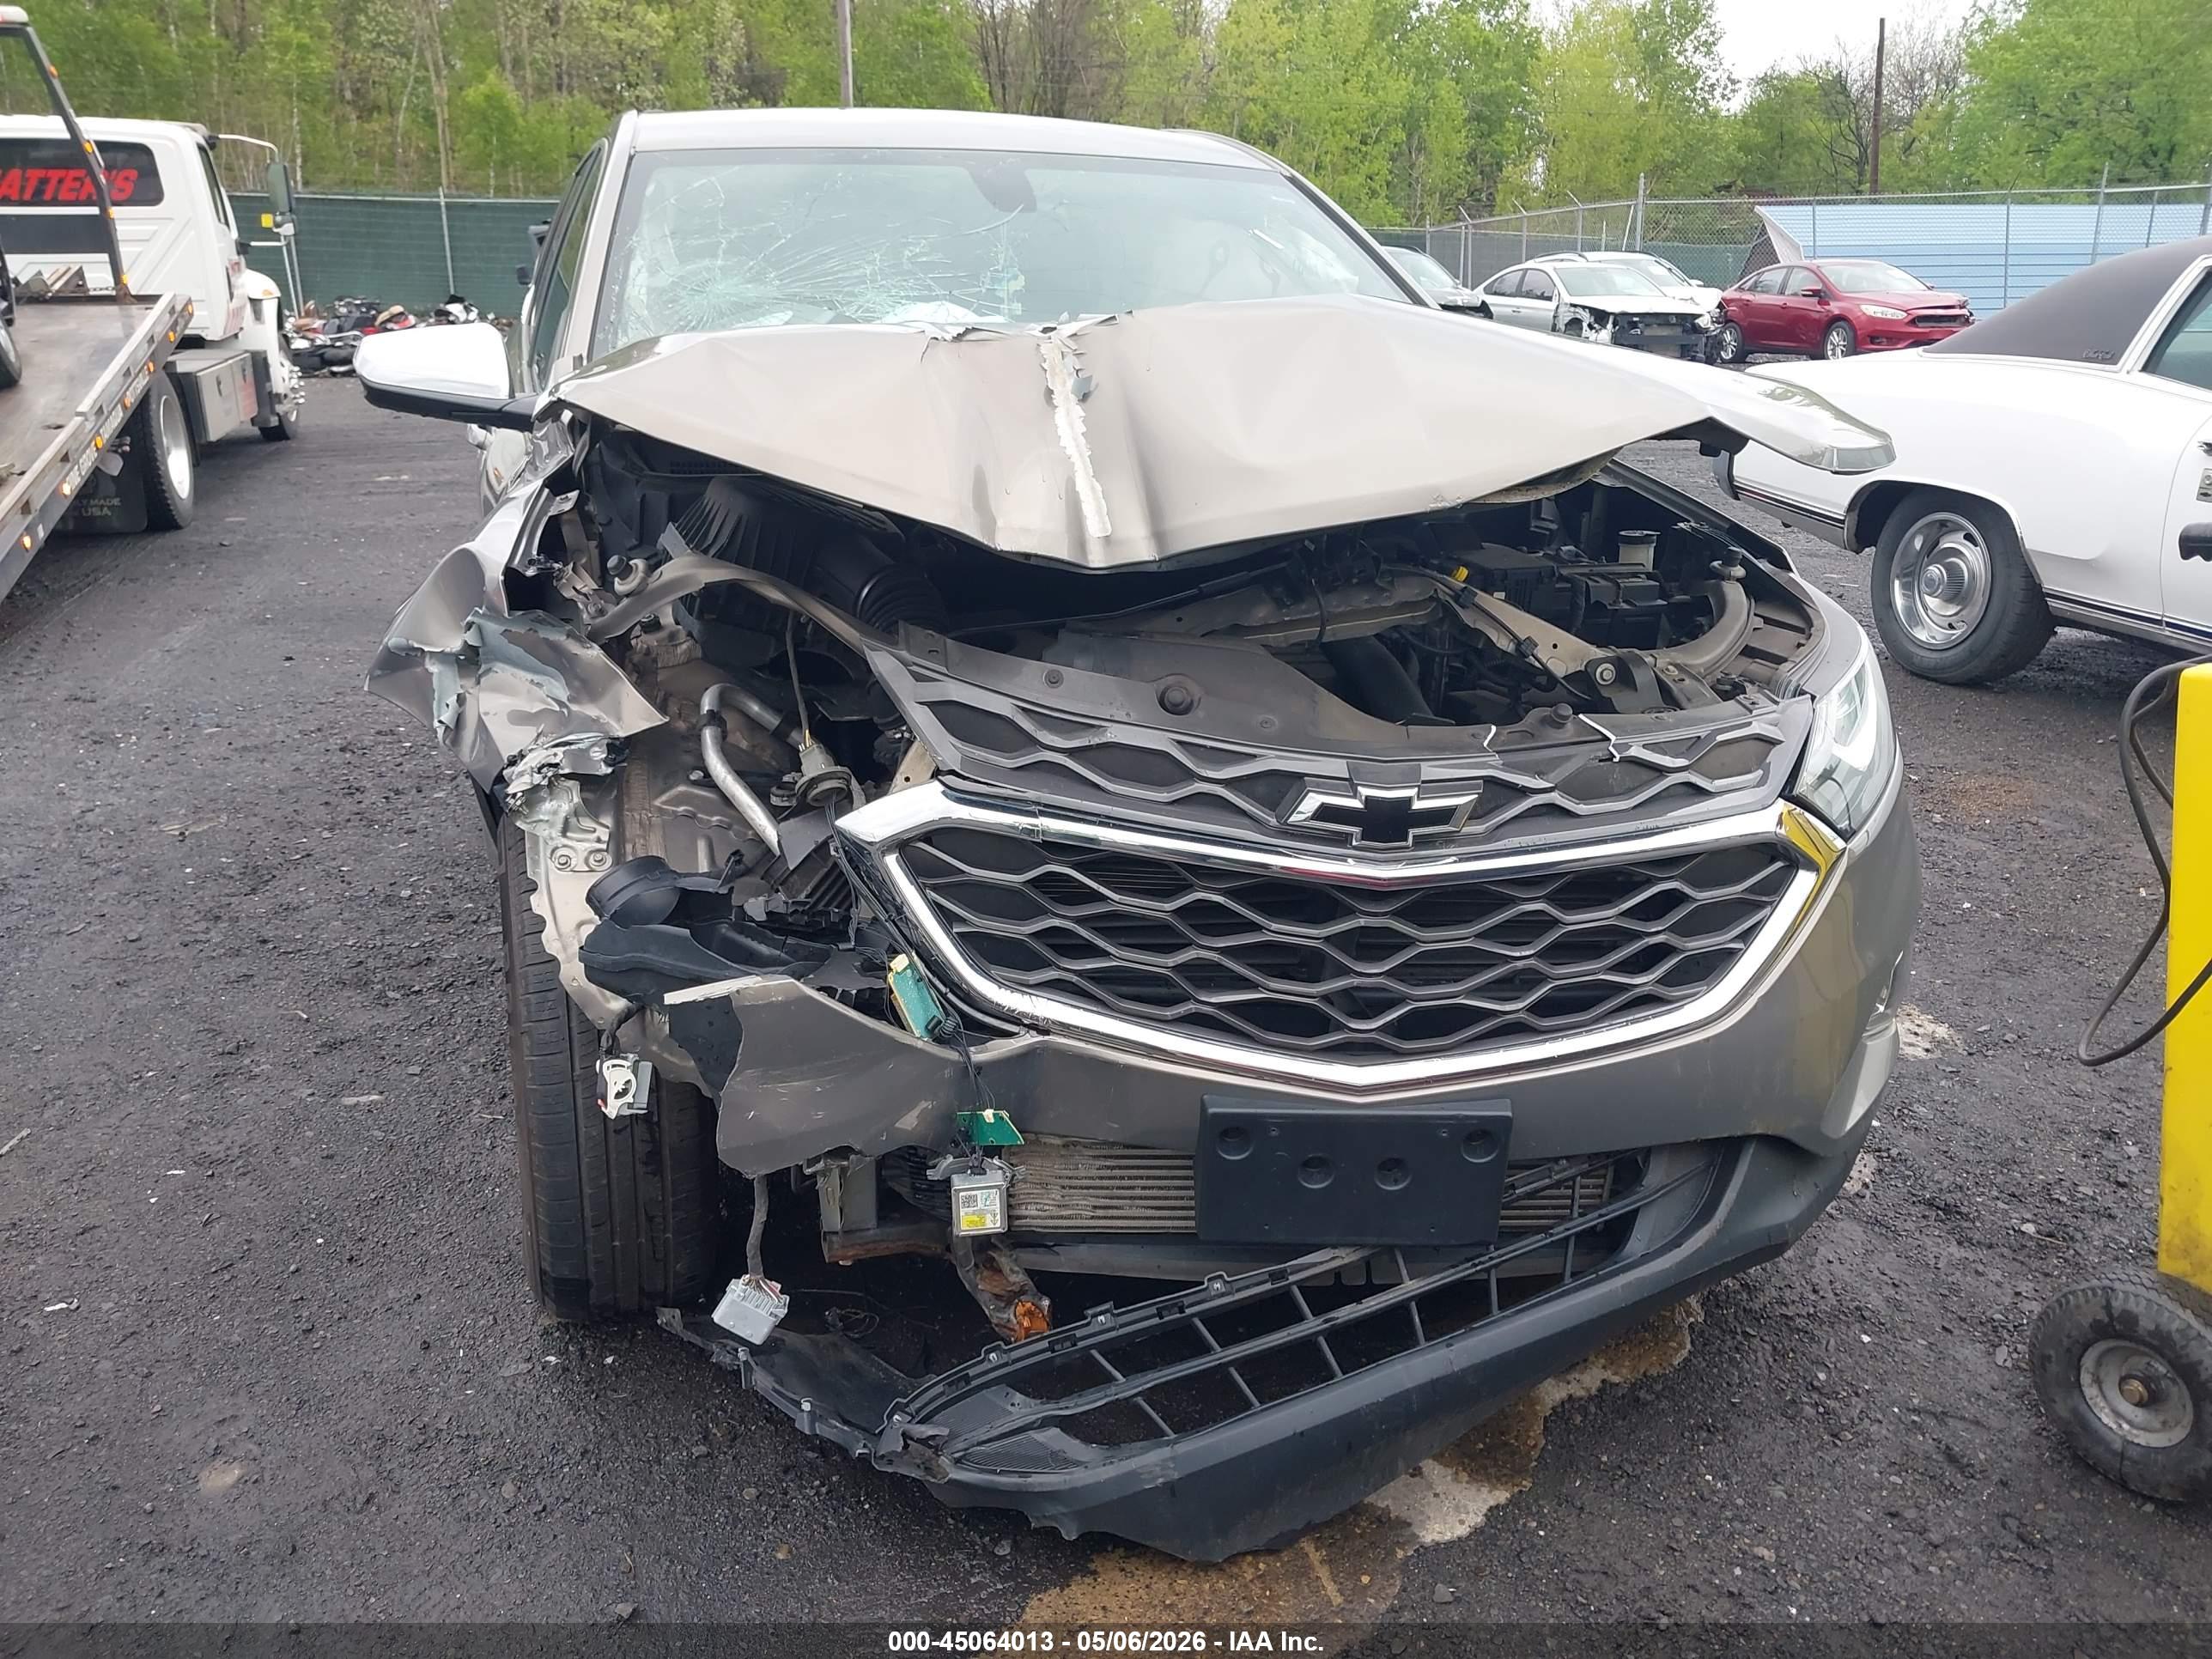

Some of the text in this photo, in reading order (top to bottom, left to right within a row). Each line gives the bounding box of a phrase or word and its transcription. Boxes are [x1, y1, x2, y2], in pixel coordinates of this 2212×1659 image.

[0, 167, 138, 201] ATTER'S
[89, 497, 121, 506] MADE
[82, 507, 112, 516] USA
